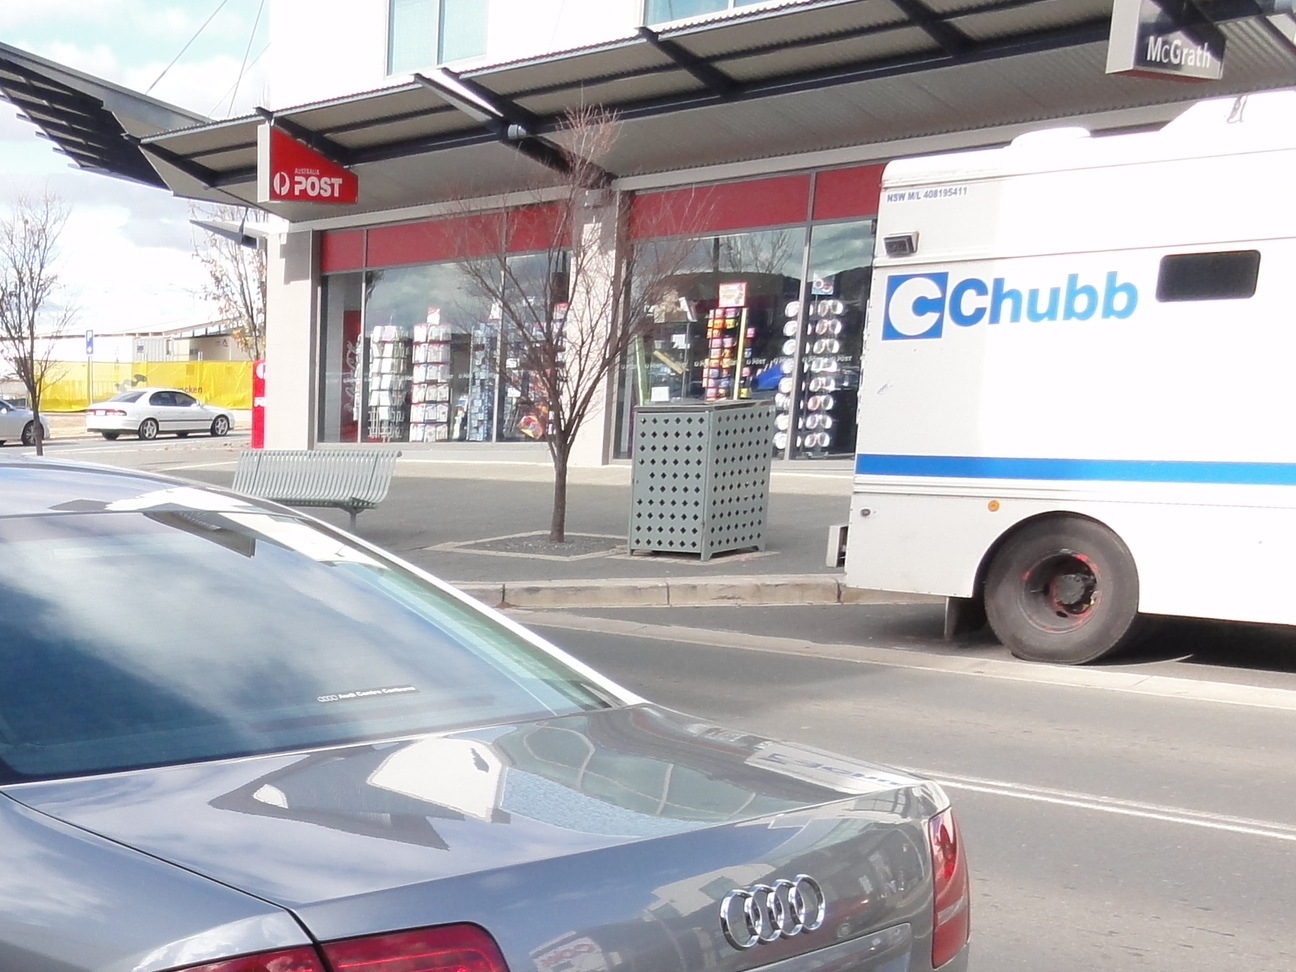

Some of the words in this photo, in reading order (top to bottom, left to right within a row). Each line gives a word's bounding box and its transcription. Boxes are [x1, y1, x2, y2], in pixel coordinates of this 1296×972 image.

[1146, 35, 1211, 69] McGrath
[294, 167, 320, 176] AUSTRALIA
[294, 175, 343, 198] POST
[886, 192, 907, 203] NSW
[923, 186, 968, 199] 408195411
[948, 270, 1139, 328] Chubb
